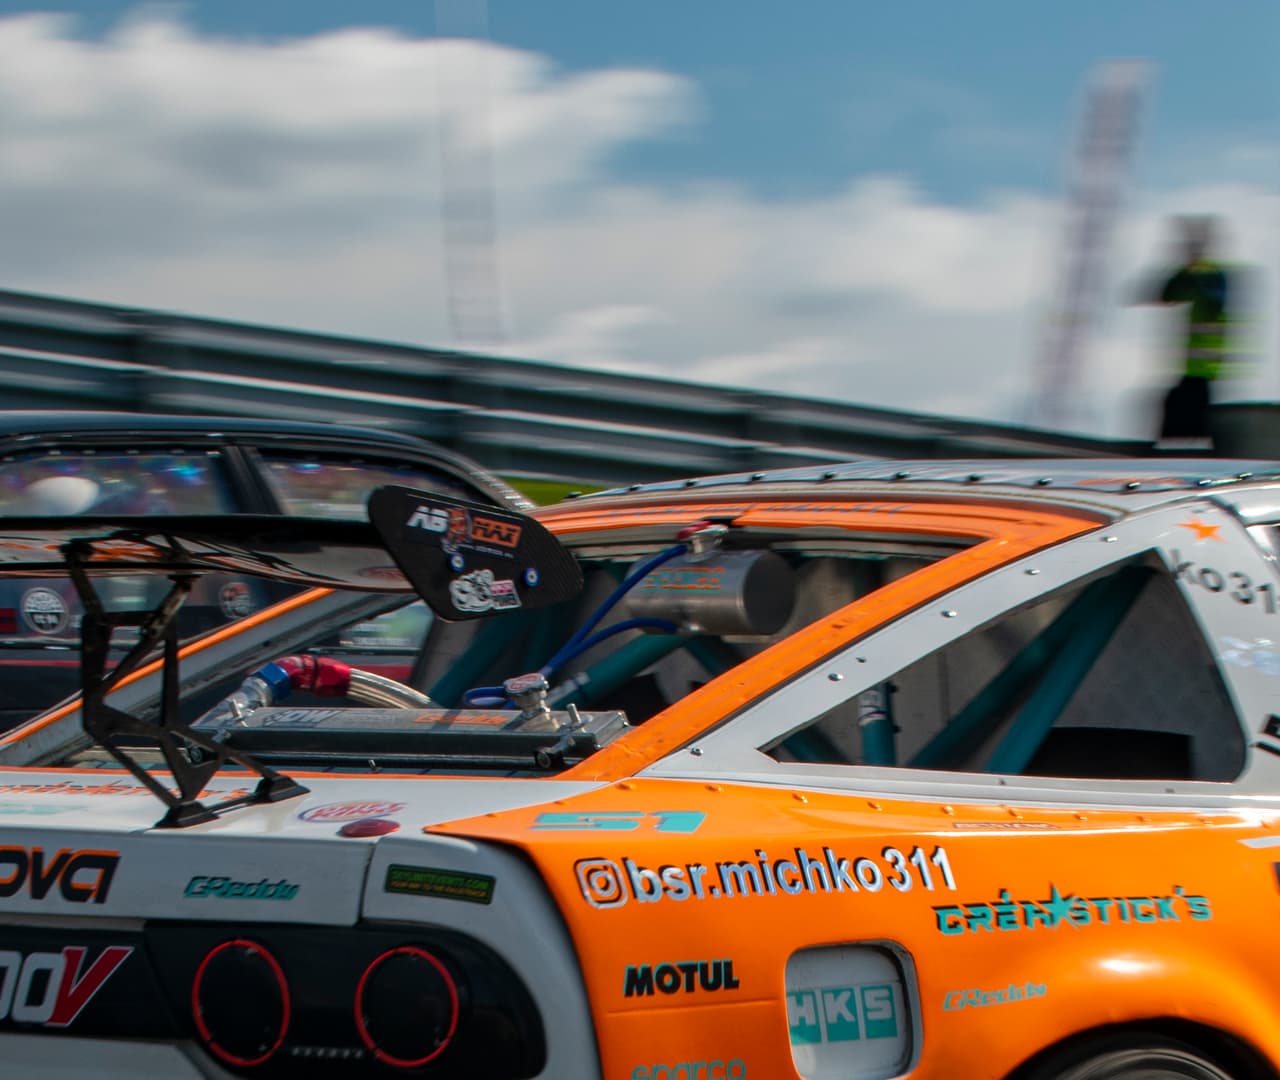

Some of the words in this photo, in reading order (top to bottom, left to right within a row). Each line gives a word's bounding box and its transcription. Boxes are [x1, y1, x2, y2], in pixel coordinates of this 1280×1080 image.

[528, 810, 707, 833] 51
[622, 846, 956, 903] bsr.michko311
[623, 960, 740, 997] MOTUL
[787, 985, 897, 1040] HKS
